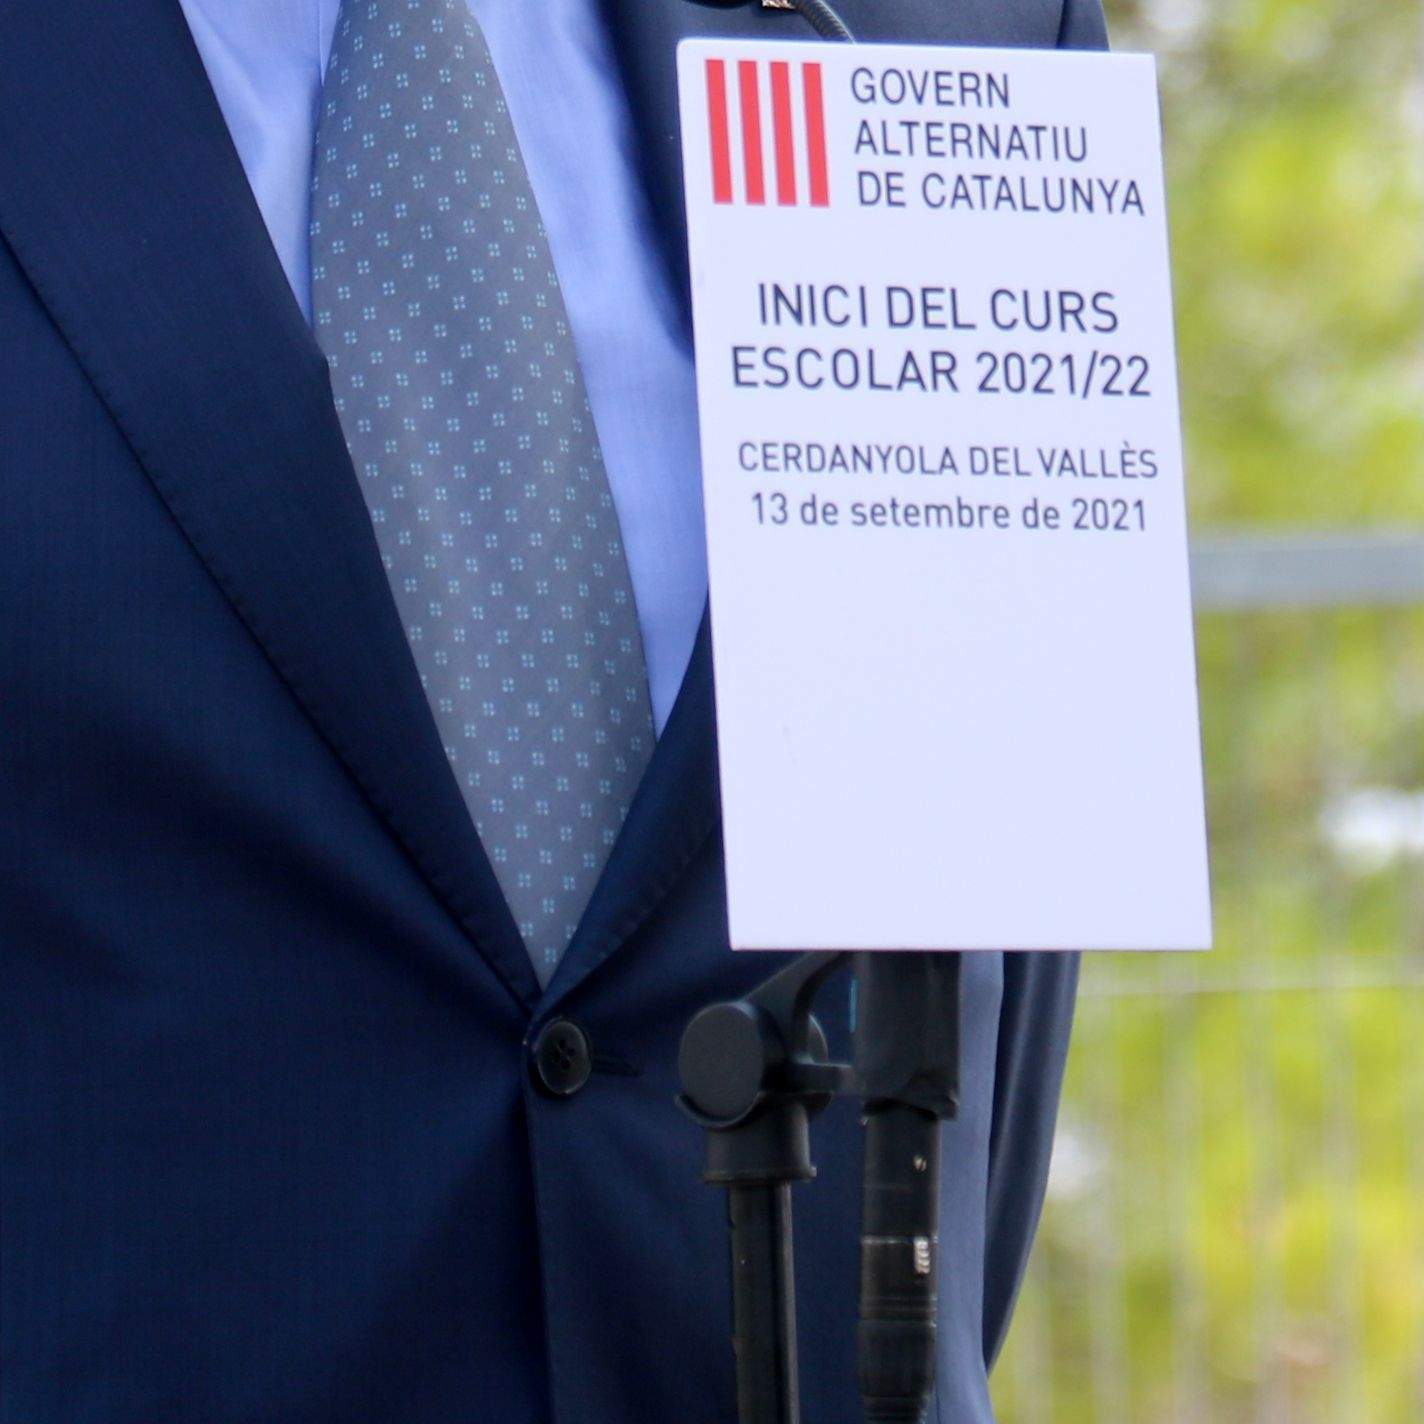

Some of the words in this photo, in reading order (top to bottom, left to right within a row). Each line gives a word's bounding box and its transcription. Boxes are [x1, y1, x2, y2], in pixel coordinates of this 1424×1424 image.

[851, 68, 1009, 108] GOVERN
[855, 120, 1087, 162] ALTERNATIU
[858, 171, 906, 207] DE
[922, 173, 1144, 216] CATALUNYA
[759, 283, 867, 327] INICI
[886, 286, 977, 329] DEL
[990, 289, 1118, 333] CURS
[732, 346, 958, 392] ESCOLAR
[976, 350, 1150, 399] 2021/22
[739, 442, 958, 475] CERDANYOLA
[969, 447, 1031, 476] DEL
[1037, 441, 1158, 478] VALLÈS
[752, 492, 788, 524] 13
[800, 494, 838, 525] de
[851, 496, 1009, 528] setembre
[1022, 498, 1059, 529] de
[1072, 498, 1145, 530] 2021
